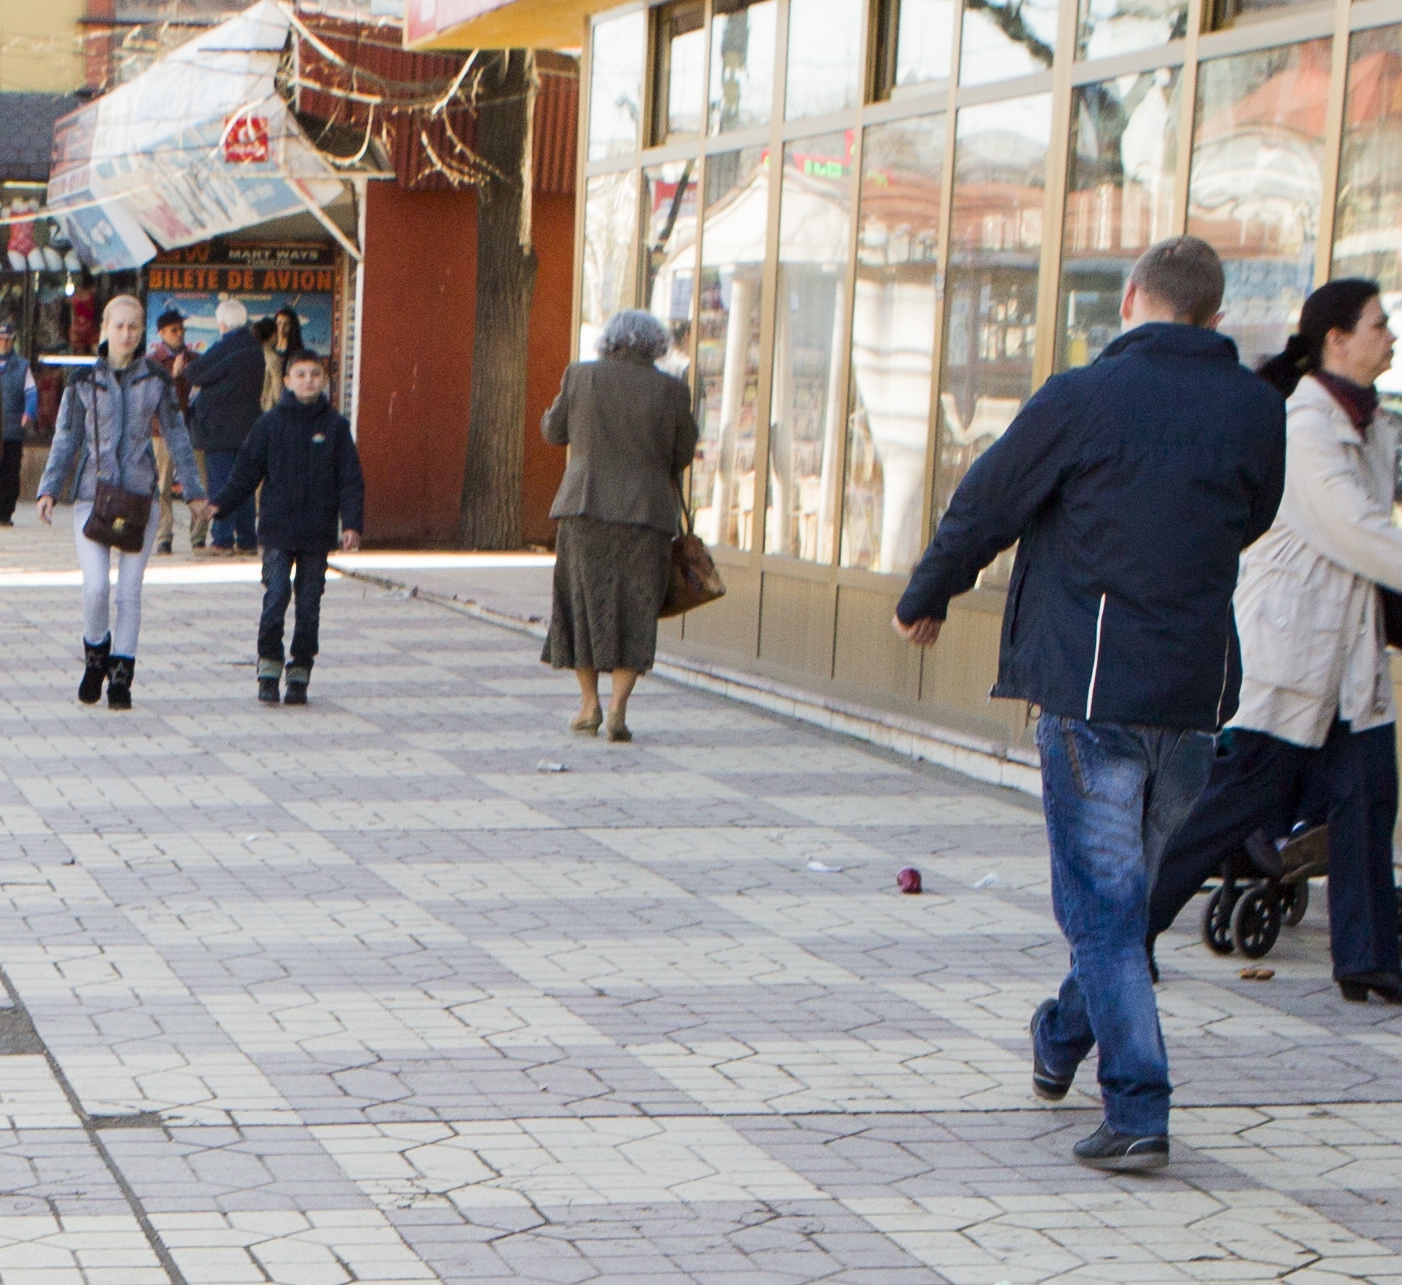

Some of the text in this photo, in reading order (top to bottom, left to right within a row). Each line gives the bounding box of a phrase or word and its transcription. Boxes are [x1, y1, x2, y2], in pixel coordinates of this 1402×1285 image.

[149, 268, 332, 290] BILETE DE AVION
